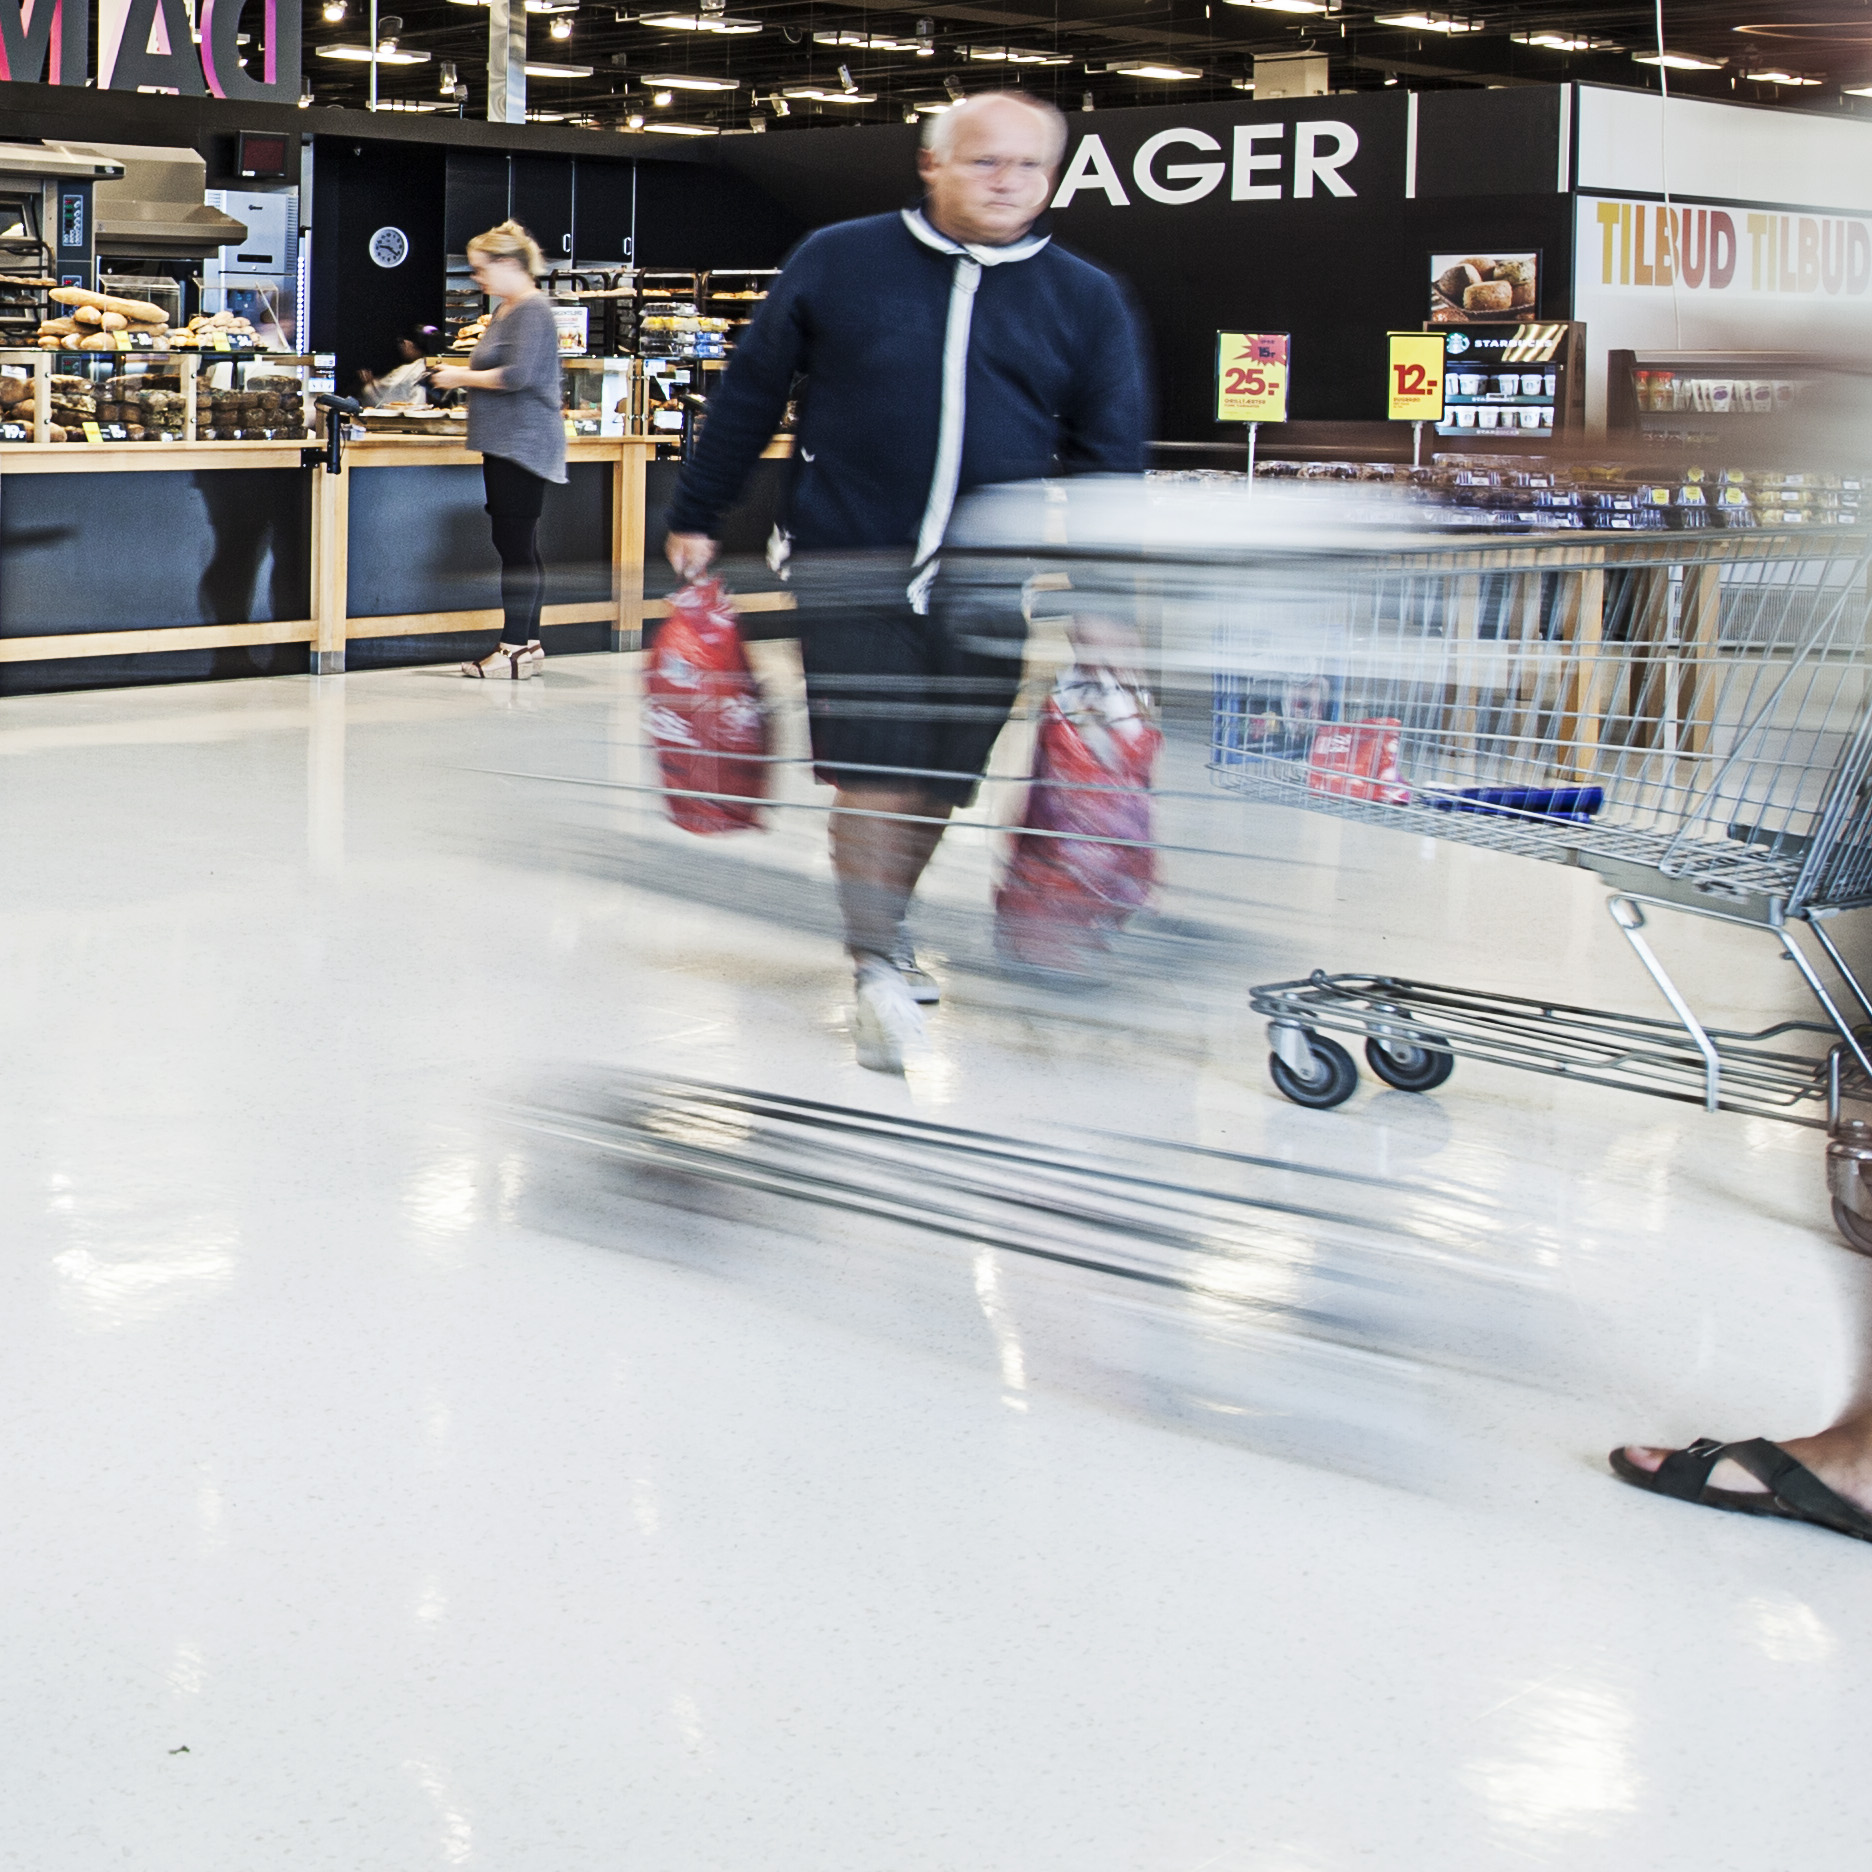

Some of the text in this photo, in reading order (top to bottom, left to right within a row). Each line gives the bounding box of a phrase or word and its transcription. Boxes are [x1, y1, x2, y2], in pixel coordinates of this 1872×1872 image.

[1041, 121, 1361, 208] AGER
[1596, 201, 1872, 296] TILBUD TILBUD
[1474, 339, 1553, 348] STARBUCKS
